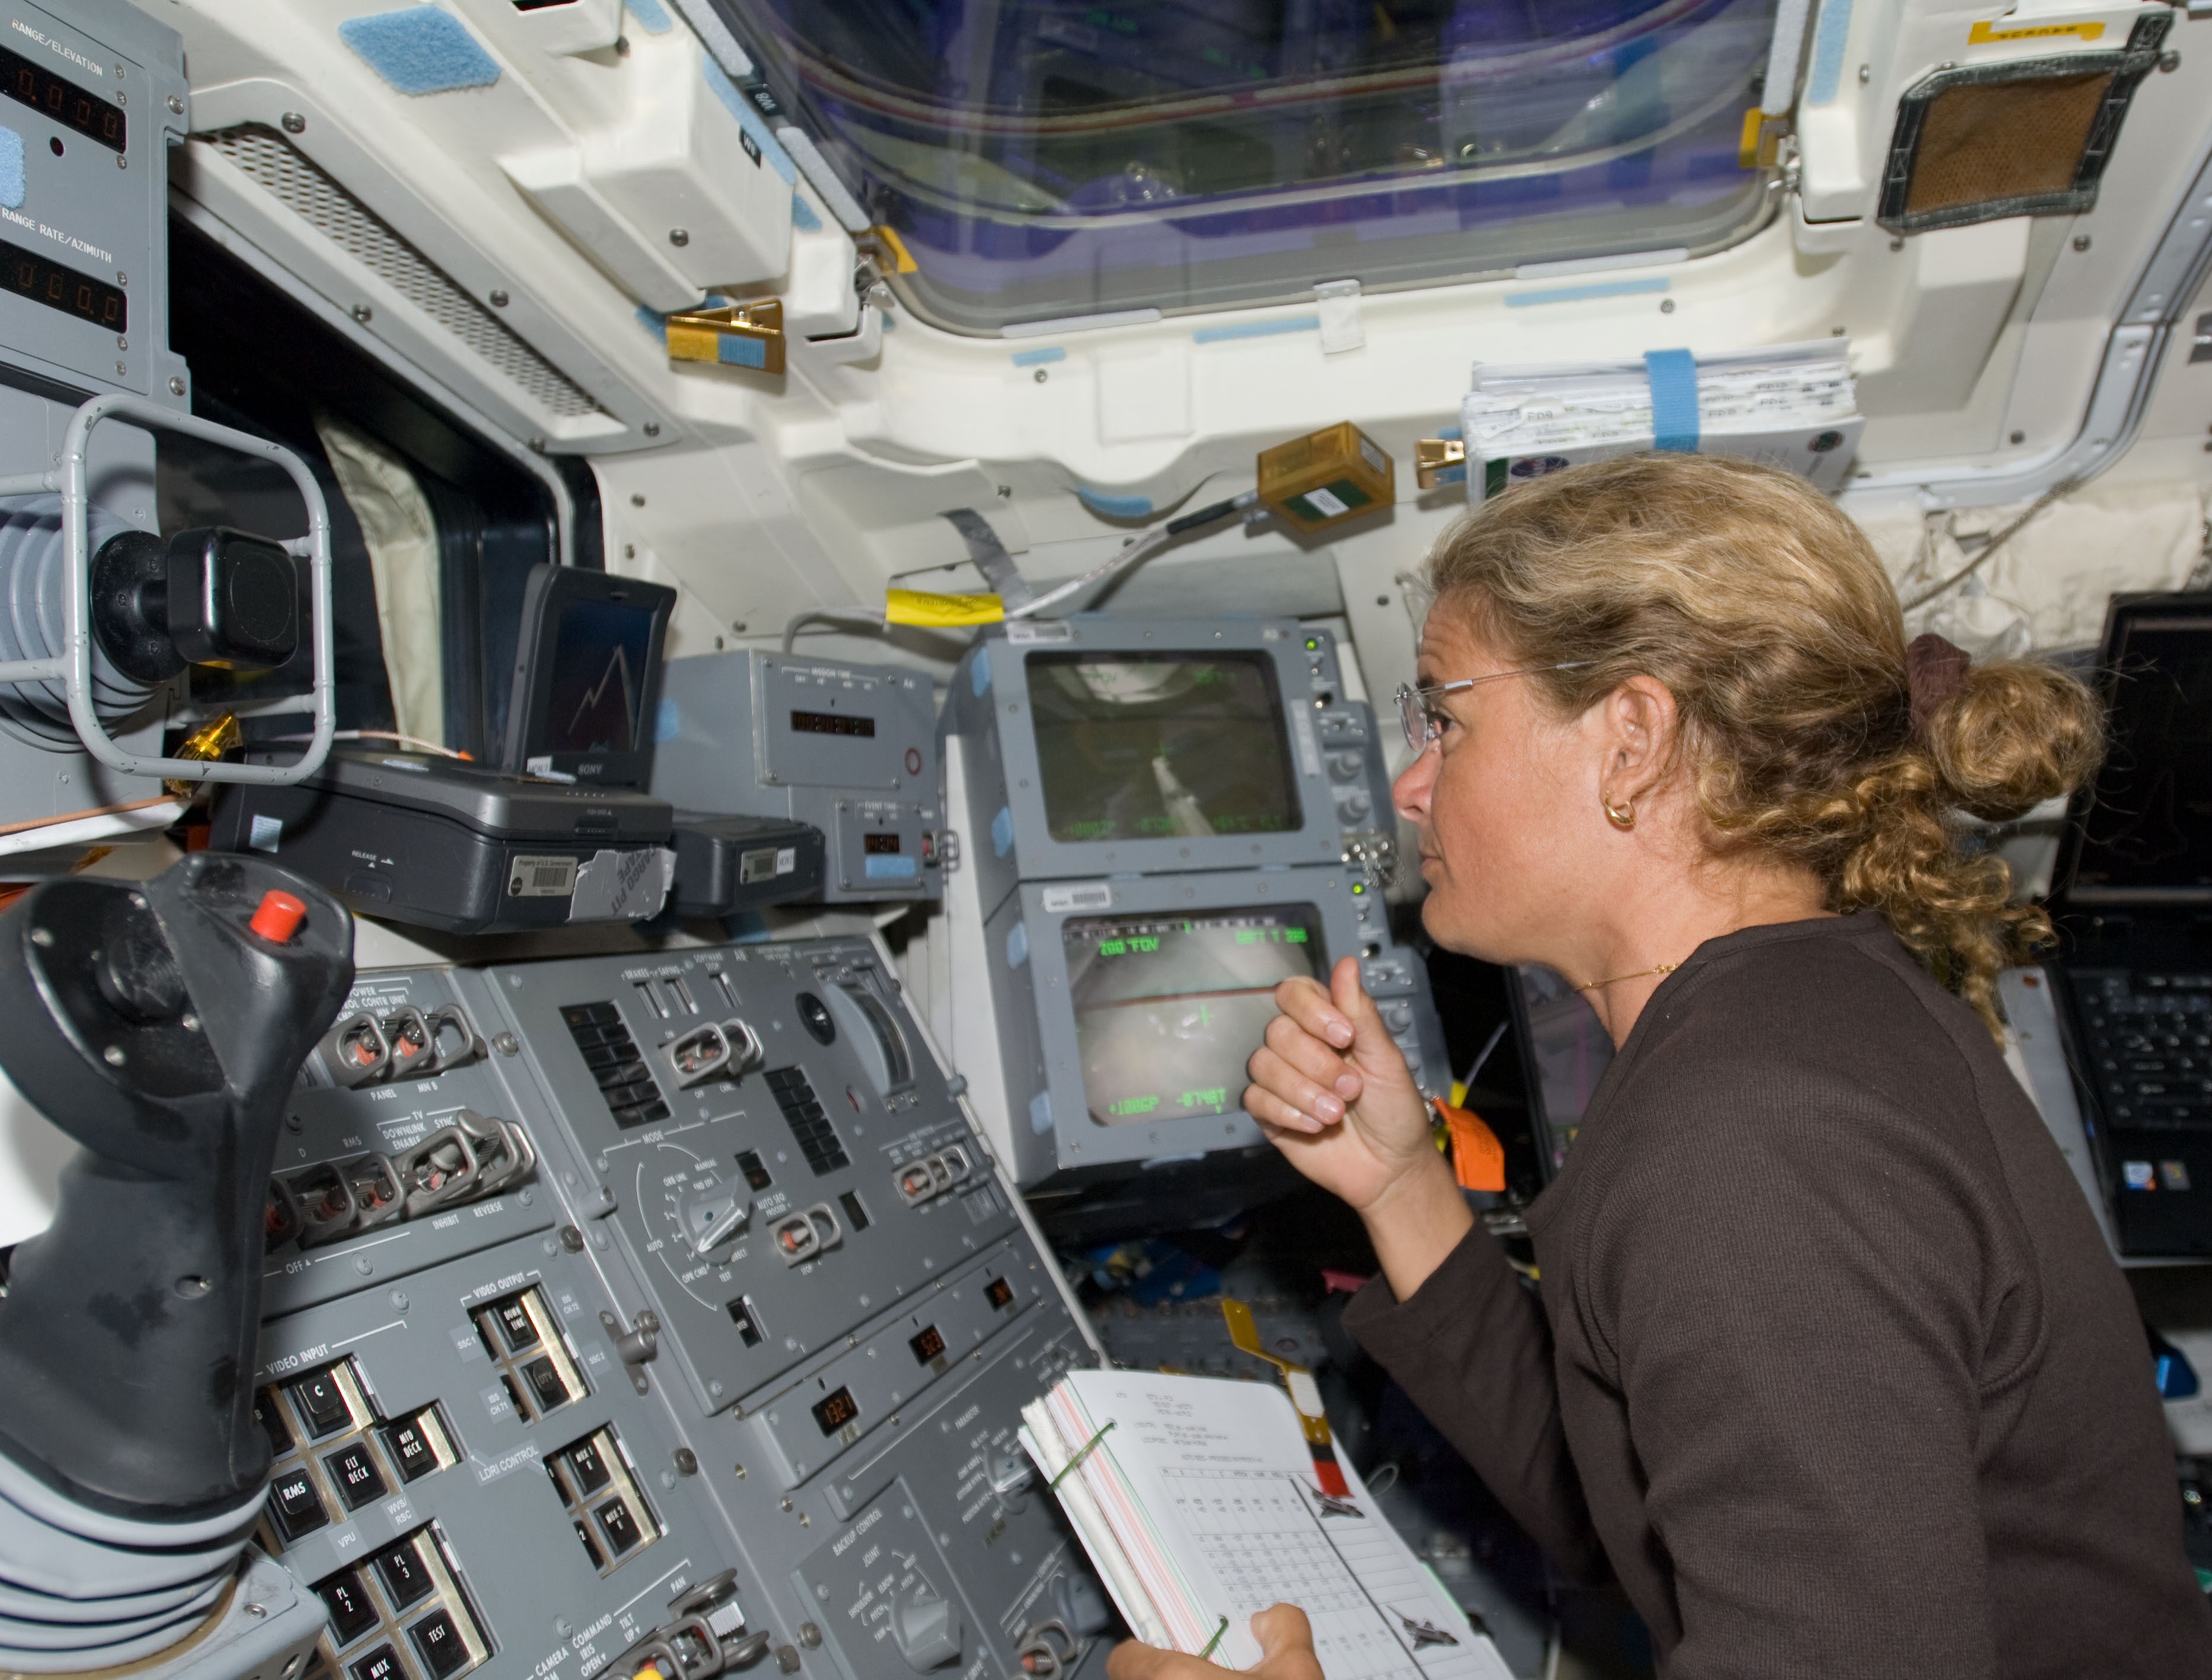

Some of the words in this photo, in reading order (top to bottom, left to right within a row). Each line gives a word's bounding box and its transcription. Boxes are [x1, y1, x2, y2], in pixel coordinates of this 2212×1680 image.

[12, 19, 102, 76] RANGE/ELEVATION
[2, 208, 35, 230] RANGE
[39, 224, 112, 264] RATE/AZIMUTH
[811, 667, 836, 677] MISSION
[837, 669, 850, 679] TIME
[577, 764, 603, 775] SONY
[865, 802, 882, 811] EVENT
[352, 850, 377, 861] RELEASE
[693, 952, 724, 963] SOFTWARE
[624, 967, 650, 980] BRAKES
[657, 965, 681, 976] SAFING
[361, 997, 389, 1007] CONTR
[388, 995, 407, 1005] UNIT
[371, 1088, 397, 1101] PANEL
[417, 1082, 431, 1094] MN
[412, 1110, 424, 1121] TV
[434, 1116, 456, 1129] SYNC
[381, 1122, 427, 1141] DOWNLINK
[642, 1130, 664, 1145] MODE
[342, 1135, 362, 1148] RMS
[694, 1159, 718, 1172] MANUAL
[663, 1175, 676, 1187] ORB
[473, 1201, 505, 1219] REVERSE
[756, 1196, 773, 1212] AUTO
[772, 1192, 786, 1205] SEQ
[432, 1213, 460, 1231] INHIBIT
[646, 1239, 664, 1253] AUTO
[671, 1234, 679, 1243] 2
[285, 1260, 304, 1276] OFF
[682, 1271, 695, 1284] OPR
[694, 1267, 708, 1280] CMD
[800, 1264, 813, 1276] STOP
[472, 1281, 497, 1299] VIDEO
[497, 1271, 526, 1290] OUTPUT
[718, 1271, 733, 1284] TEST
[457, 1337, 471, 1351] SSC
[266, 1355, 298, 1375] VIDEO
[301, 1343, 330, 1364] INPUT
[538, 1371, 554, 1386] DTV
[314, 1384, 325, 1398] C
[487, 1392, 501, 1404] ISS
[490, 1405, 502, 1416] CH
[499, 1401, 509, 1412] 71
[398, 1429, 415, 1445] MID
[403, 1440, 423, 1459] DECK
[345, 1456, 359, 1471] FLT
[479, 1464, 500, 1482] LDRI
[499, 1445, 540, 1472] CONTROL
[348, 1466, 370, 1485] DECK
[282, 1481, 307, 1502] RMS
[387, 1496, 409, 1515] WVS/
[394, 1509, 413, 1526] RSC
[338, 1531, 357, 1549] VPU
[832, 1530, 857, 1557] BACKUP
[855, 1508, 883, 1535] CONTROL
[393, 1554, 406, 1568] PL
[862, 1544, 881, 1568] JOINT
[901, 1553, 917, 1570] WRIST
[401, 1566, 410, 1579] 3
[670, 1575, 687, 1594] PAN
[877, 1572, 895, 1595] ELBOW
[901, 1573, 915, 1591] PITCH
[336, 1585, 349, 1601] PL
[344, 1599, 354, 1614] 2
[847, 1590, 874, 1620] SHOULDER
[619, 1611, 634, 1630] TILT
[869, 1604, 885, 1623] PITCH
[428, 1624, 447, 1645] TEST
[624, 1628, 635, 1643] UP
[874, 1626, 887, 1643] YAW
[535, 1646, 570, 1677] CAMERA
[572, 1612, 612, 1649] COMMAND
[579, 1643, 596, 1661] IRIS
[370, 1657, 391, 1680] MUX
[580, 1655, 603, 1678] OPEN
